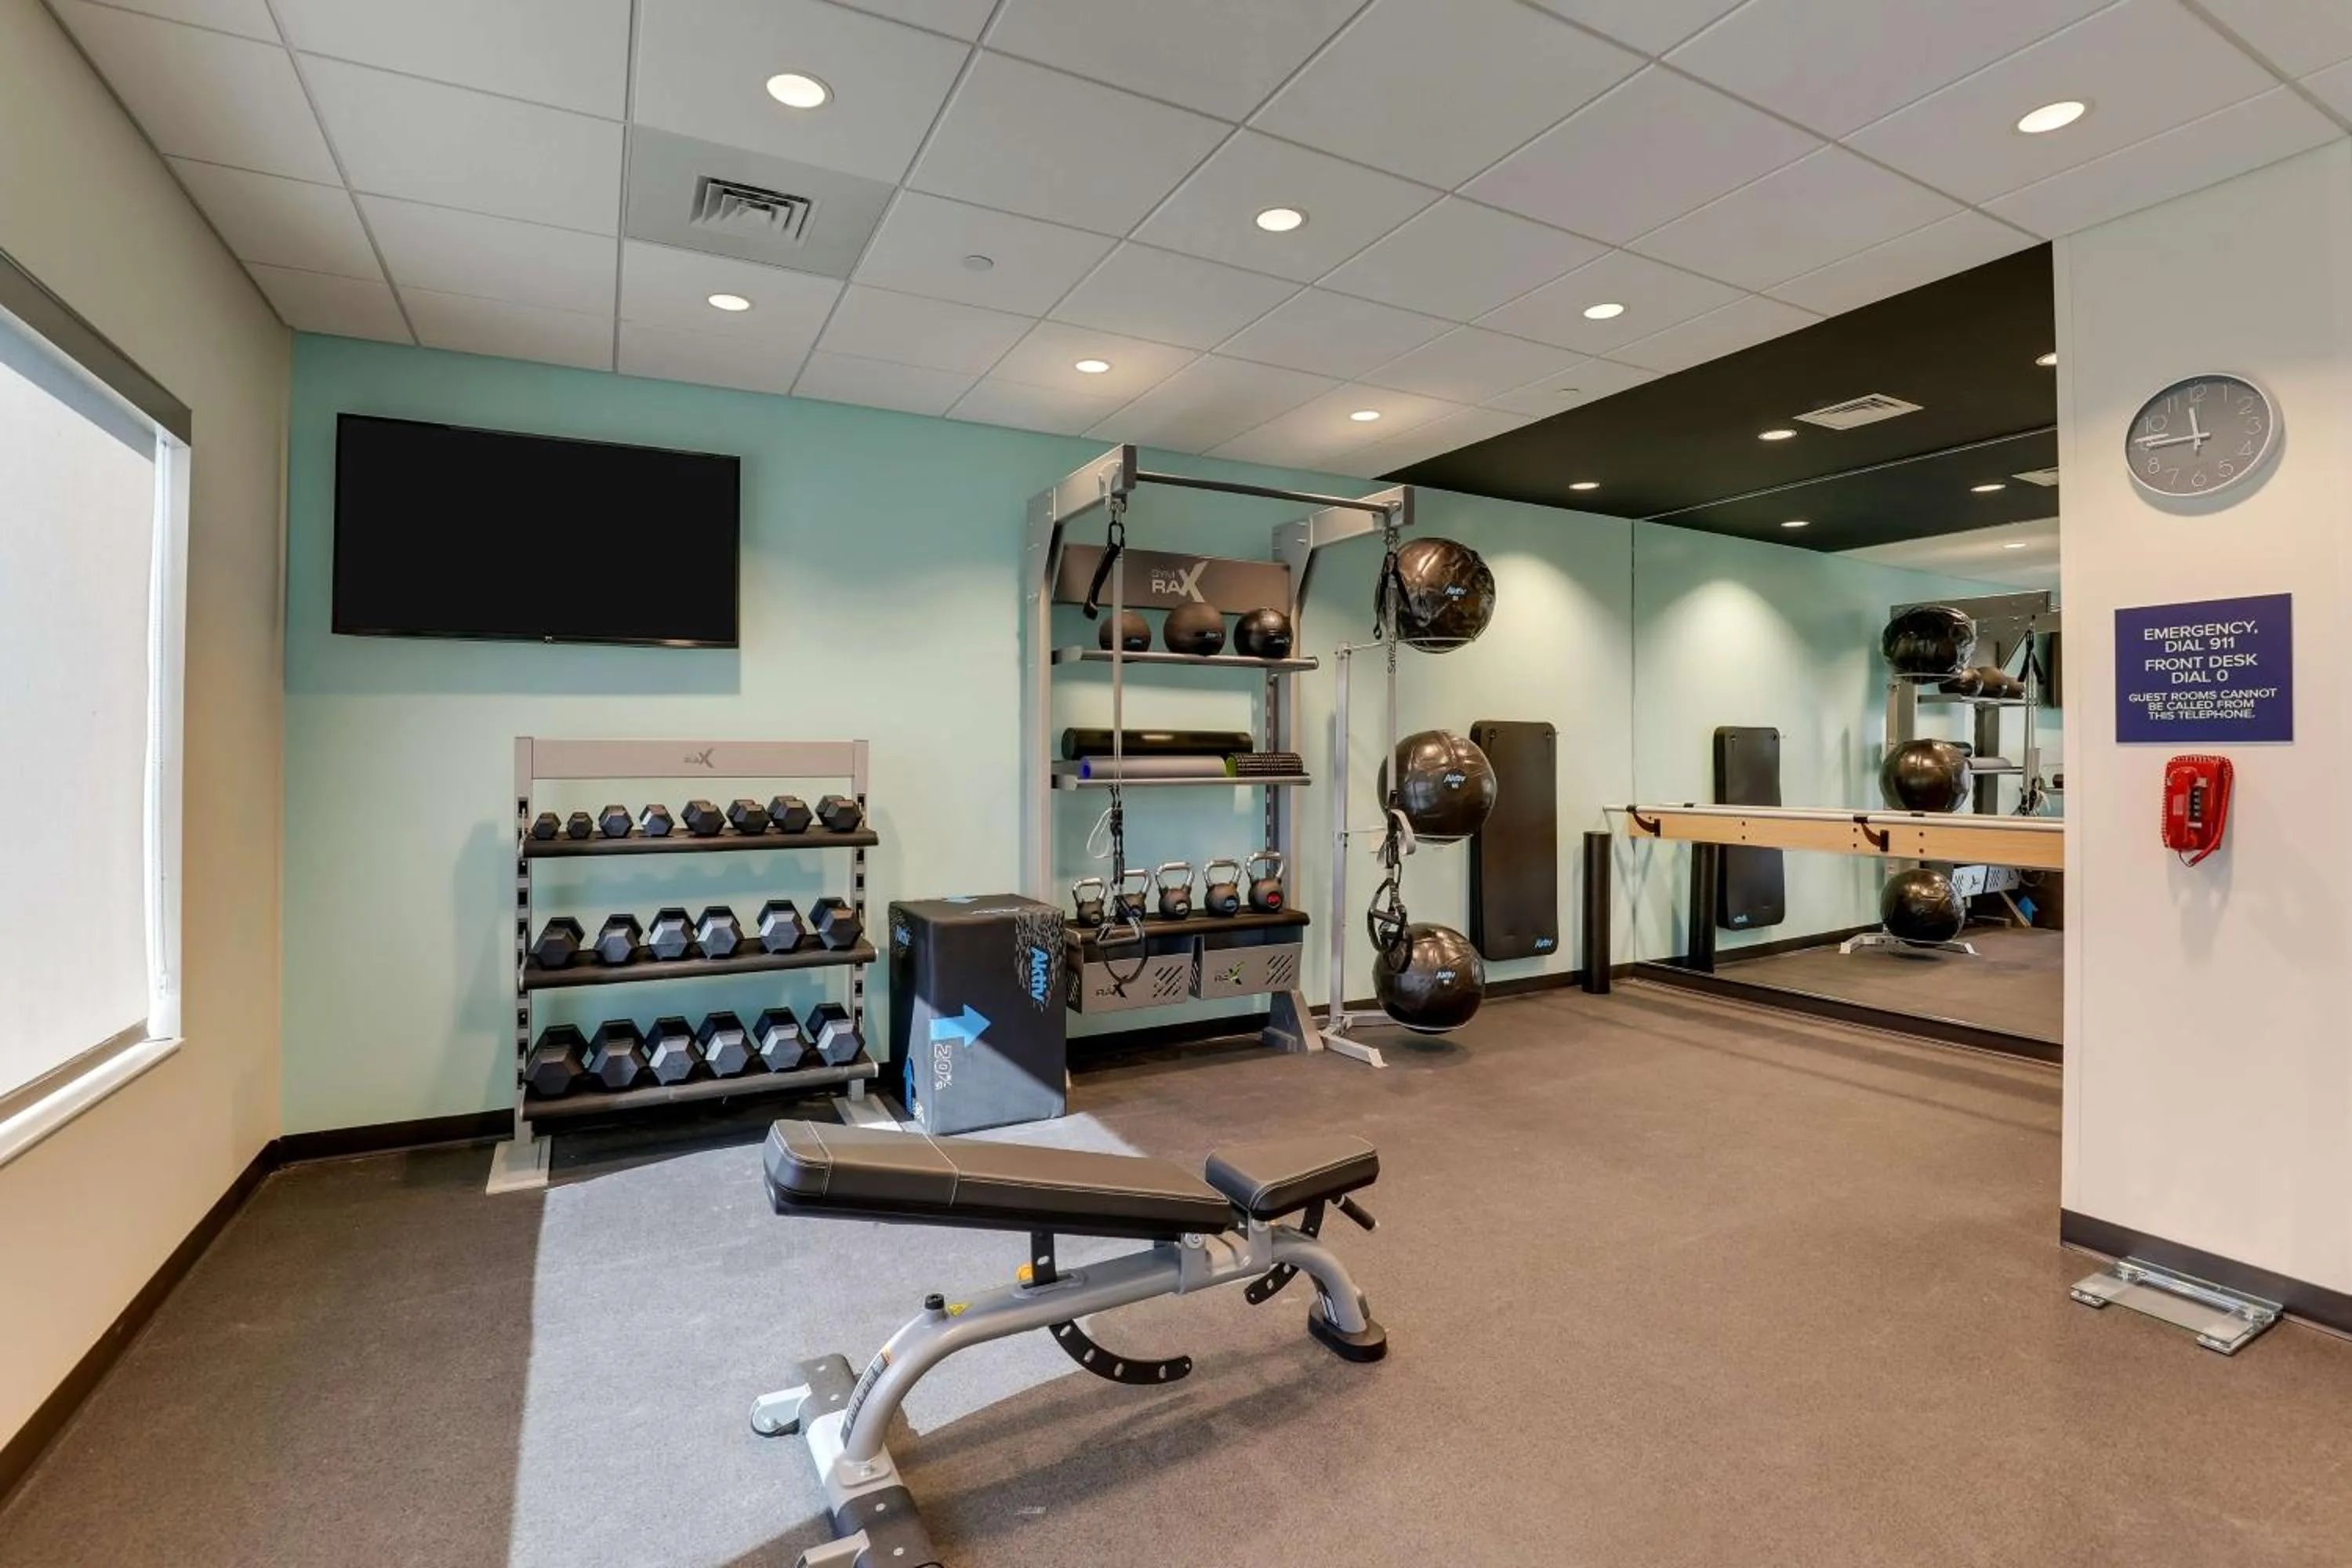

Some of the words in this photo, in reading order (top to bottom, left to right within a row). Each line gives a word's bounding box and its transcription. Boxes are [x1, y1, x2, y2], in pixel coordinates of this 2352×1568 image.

[2238, 396, 2254, 415] 2
[2144, 414, 2169, 434] 10
[2245, 416, 2262, 435] 3
[2238, 440, 2254, 458] 4
[2147, 456, 2160, 475] 8
[2218, 459, 2234, 478] 5
[2165, 468, 2180, 485] 7
[2191, 470, 2207, 488] 6
[2144, 620, 2259, 641] EMERGENCY,
[2165, 641, 2205, 653] DIAL
[2209, 637, 2234, 650] 911
[2144, 656, 2204, 672] FRONT
[2209, 653, 2259, 668] DESK
[2171, 671, 2212, 684] DIAL
[2128, 692, 2168, 703] GUEST
[2170, 690, 2218, 701] ROOMS
[2220, 688, 2278, 699] CANNOT
[2147, 702, 2164, 711] BE
[2166, 699, 2214, 710] CALLED
[2216, 699, 2255, 710] FROM
[2148, 710, 2175, 720] THIS
[2178, 708, 2256, 720] TELEPHONE.
